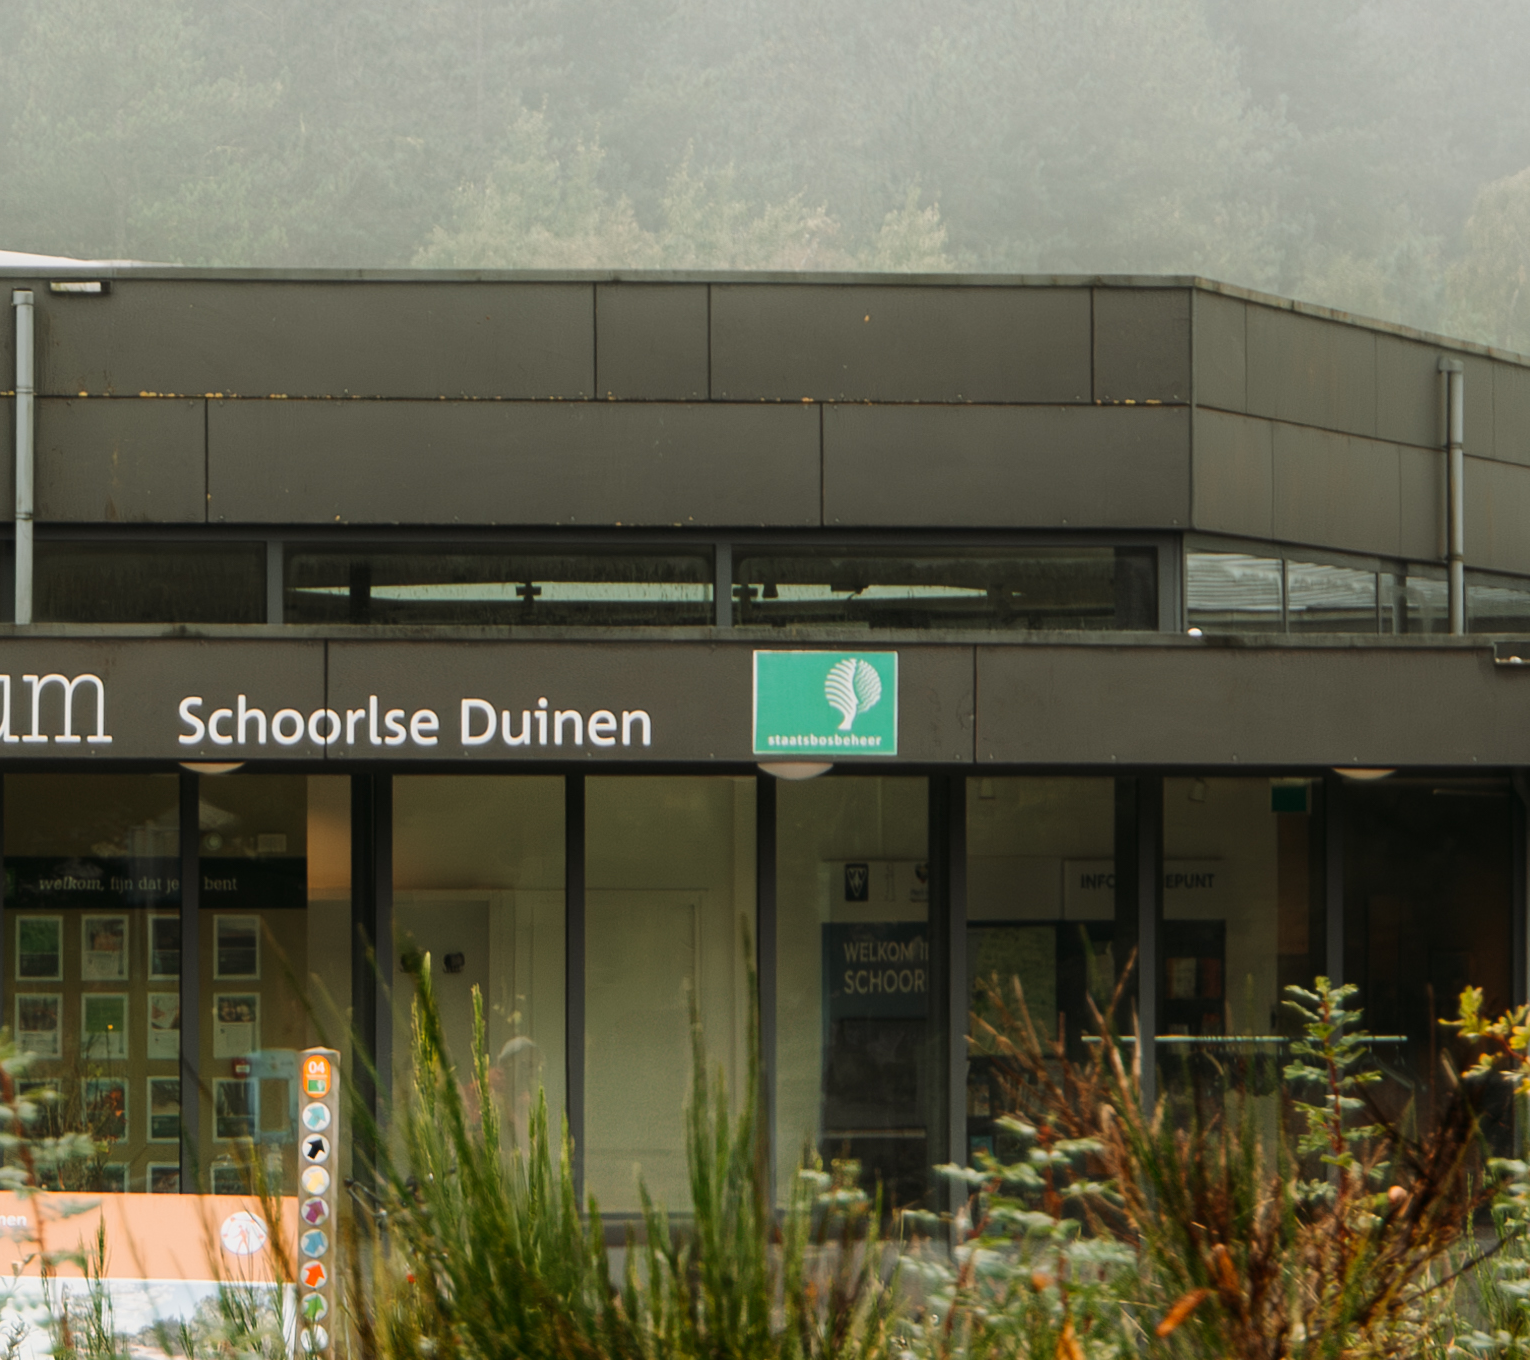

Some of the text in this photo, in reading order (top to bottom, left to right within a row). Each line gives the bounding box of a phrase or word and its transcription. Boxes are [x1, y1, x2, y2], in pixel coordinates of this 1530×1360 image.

[178, 694, 652, 746] Schoorlse Duinen
[765, 733, 882, 748] staatsbosbeheer
[138, 876, 162, 890] dat
[165, 876, 180, 895] je
[204, 876, 237, 891] bent
[843, 941, 914, 962] WELKOM
[843, 969, 927, 995] SCHOOR
[308, 1061, 325, 1074] 04
